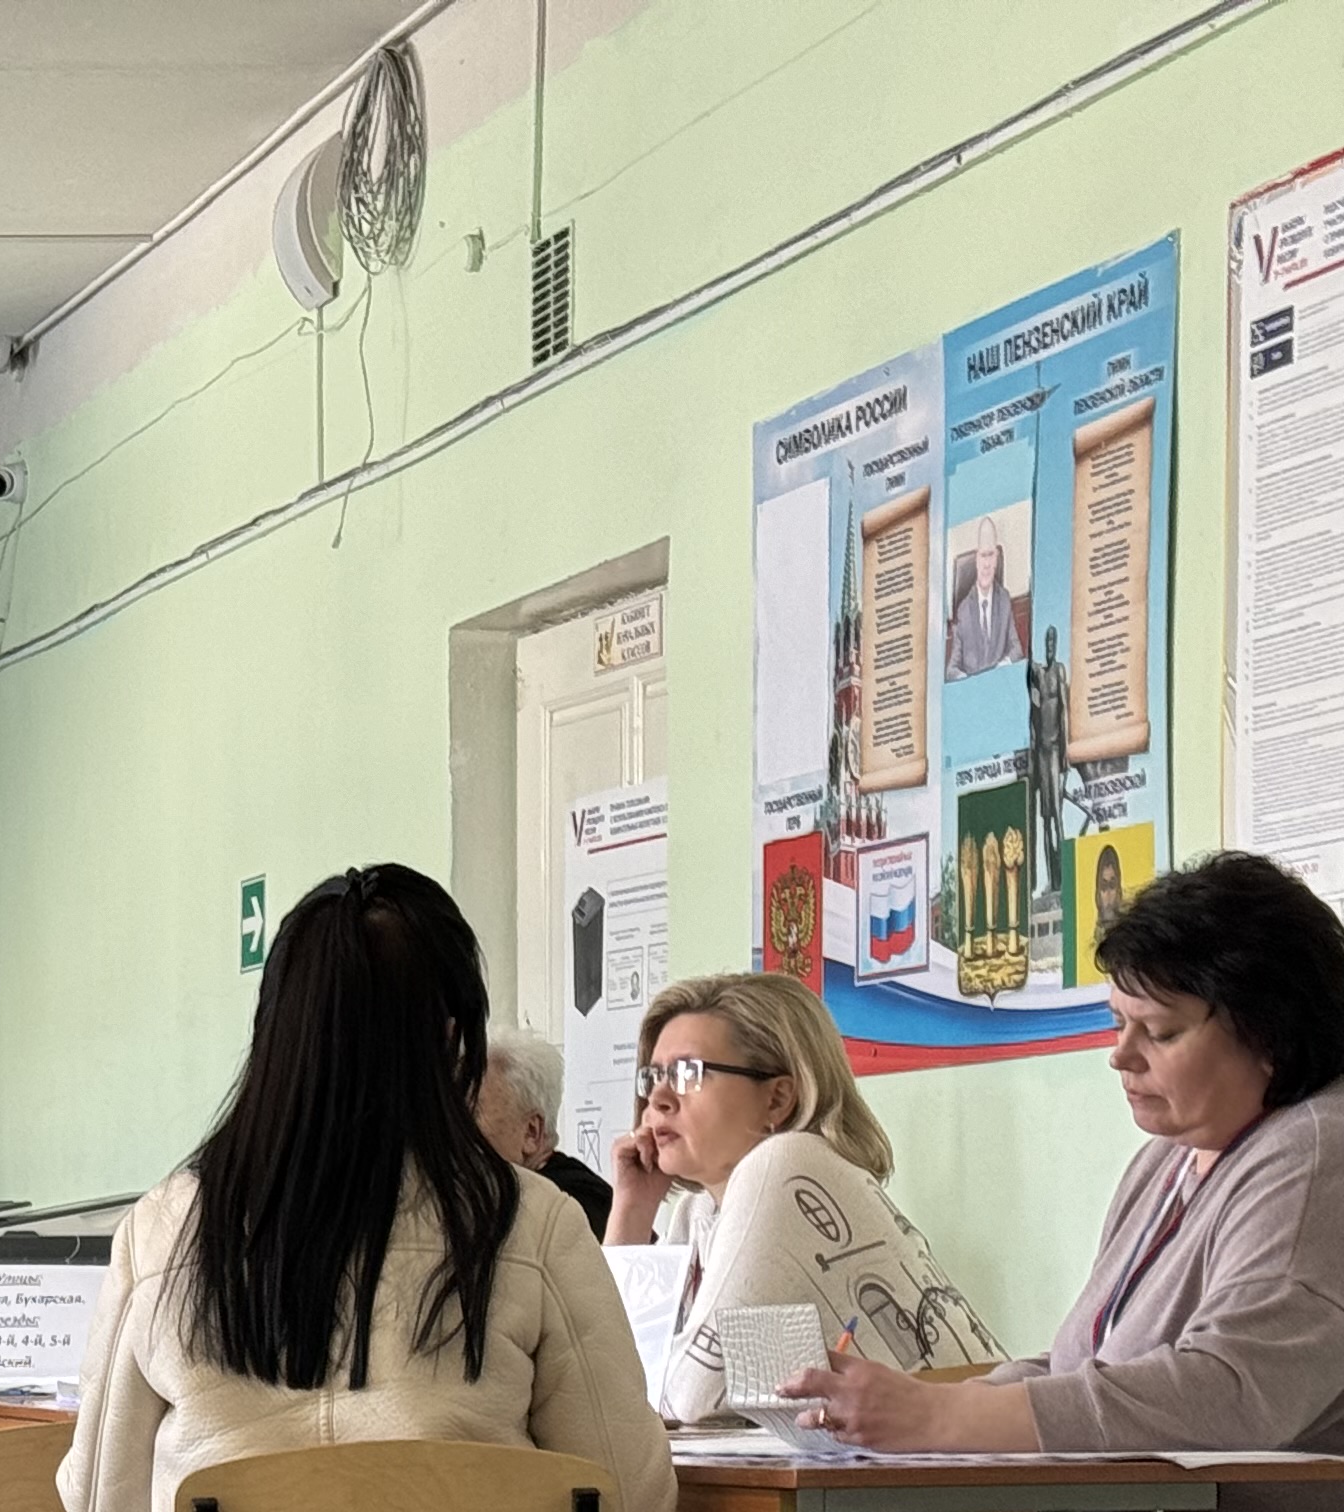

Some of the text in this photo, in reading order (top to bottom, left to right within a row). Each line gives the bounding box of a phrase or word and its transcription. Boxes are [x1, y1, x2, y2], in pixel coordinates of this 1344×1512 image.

[967, 343, 1002, 384] НАШ
[1003, 292, 1104, 367] ПЕНЗЕНСКИЙ
[1106, 271, 1150, 323] КРАЙ
[855, 384, 908, 432] РОССИИ
[49, 1333, 72, 1347] 5-й
